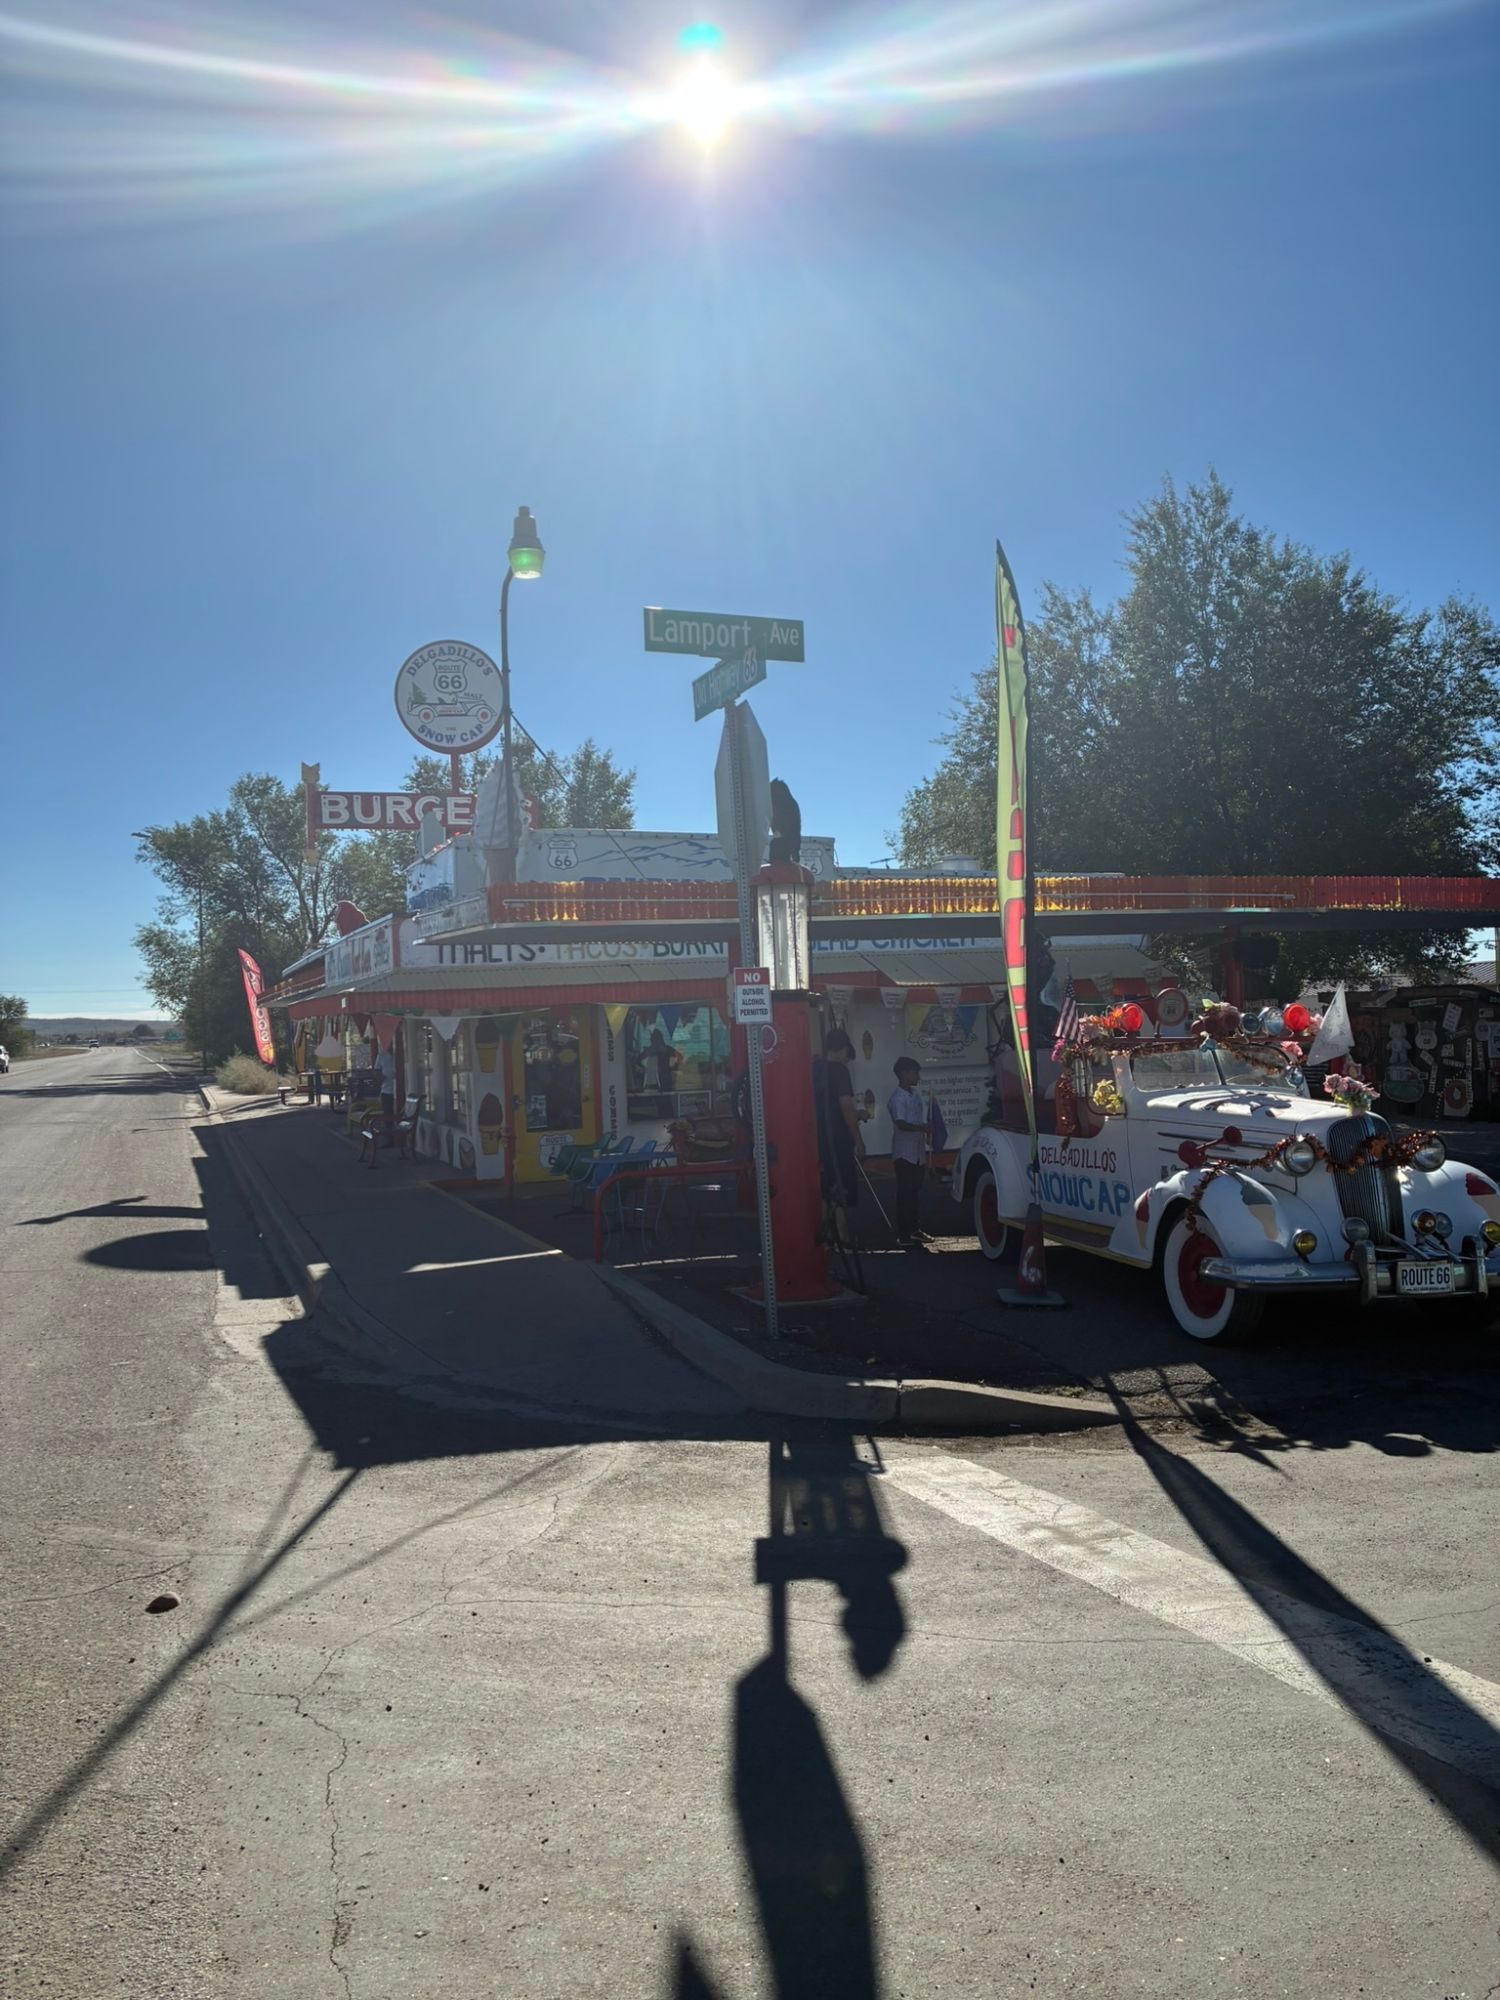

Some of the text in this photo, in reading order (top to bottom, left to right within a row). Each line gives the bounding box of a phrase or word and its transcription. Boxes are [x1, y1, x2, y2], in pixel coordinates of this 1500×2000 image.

[650, 610, 800, 651] Lamport Ave
[406, 646, 494, 677] DELGADILLO'S
[438, 664, 461, 672] ROUTE
[743, 647, 758, 683] 66
[437, 675, 463, 690] 66
[417, 723, 485, 745] SNOW CAP
[320, 794, 533, 826] BURGE
[554, 855, 572, 867] 66
[743, 972, 761, 983] NO
[742, 988, 765, 996] OUTSIDE
[742, 998, 766, 1006] ALCOHOL
[740, 1007, 768, 1016] PERMITTED
[1041, 1146, 1117, 1173] DELGADILLO'S
[1402, 1266, 1451, 1286] ROUTE 66
